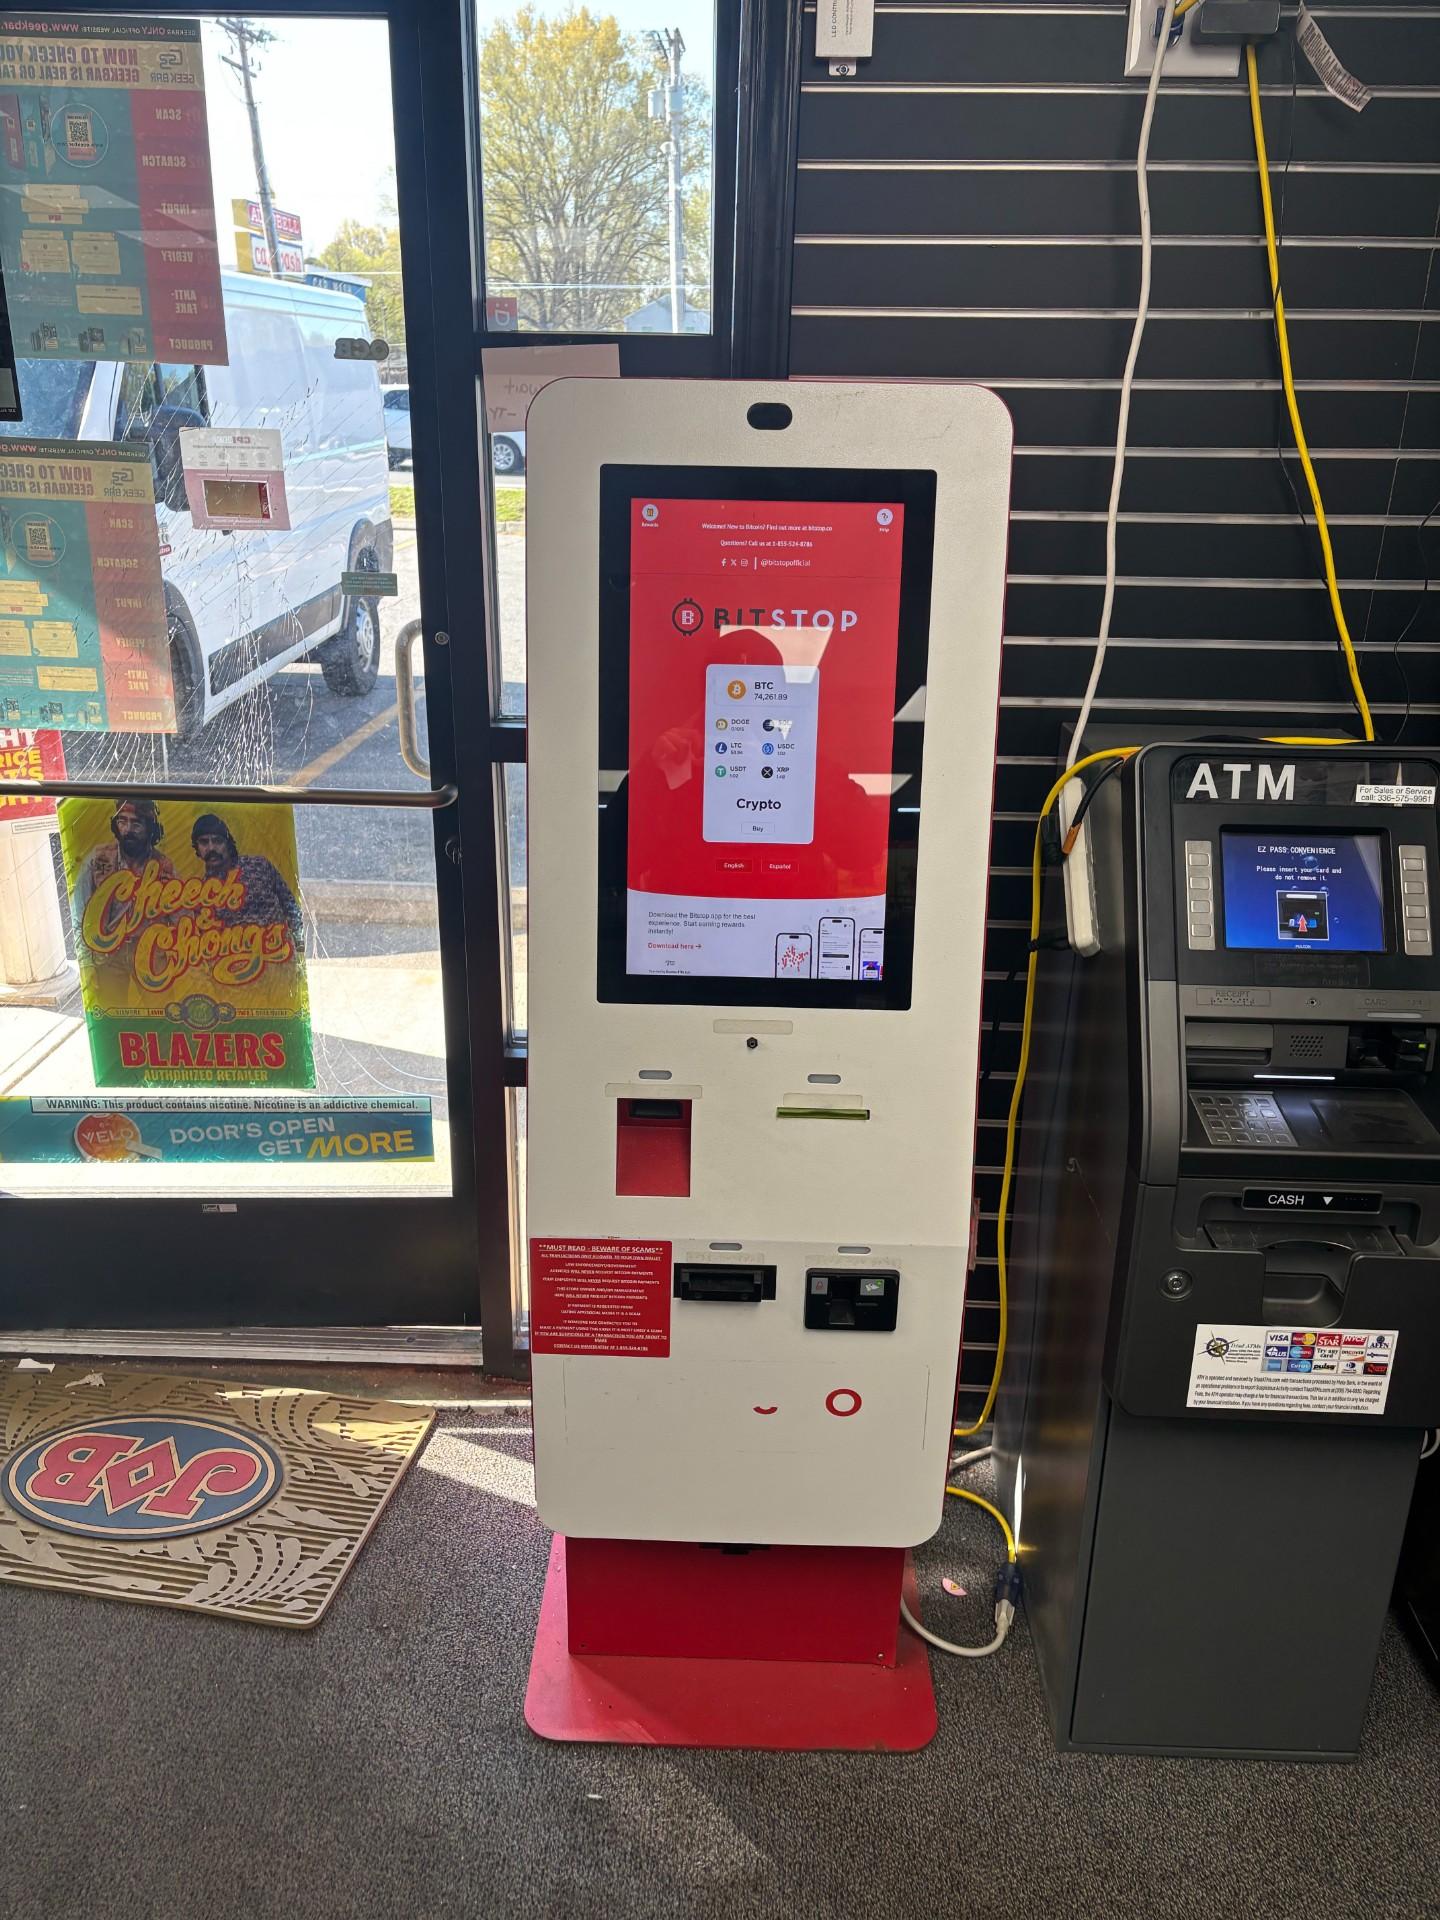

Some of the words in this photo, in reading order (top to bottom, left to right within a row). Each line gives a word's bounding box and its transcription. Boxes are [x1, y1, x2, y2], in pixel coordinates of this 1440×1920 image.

[714, 607, 858, 632] BITSTOP
[754, 682, 774, 690] BTC
[1185, 762, 1296, 800] ATM
[1360, 786, 1372, 795] For
[1374, 787, 1394, 795] Sales
[1404, 788, 1432, 796] Service
[736, 798, 782, 811] Crypto
[752, 824, 764, 833] Buy
[1290, 847, 1336, 855] CONVENIENCE
[82, 859, 248, 953] Cheech
[196, 907, 224, 930] &
[1216, 990, 1250, 998] RECEIPT
[1364, 998, 1388, 1006] CARD
[118, 1031, 286, 1069] BLAZERS
[144, 1070, 213, 1082] AUTHORIZED
[216, 1070, 268, 1082] RETAILER
[46, 1100, 100, 1109] WARNING:
[102, 1100, 124, 1110] This
[126, 1100, 163, 1112] product
[166, 1100, 206, 1110] contains
[210, 1100, 252, 1110] nicotine.
[254, 1100, 296, 1110] Nicotine
[298, 1100, 306, 1110] is
[323, 1100, 368, 1110] addictive
[370, 1100, 418, 1110] chemical.
[82, 1126, 134, 1144] VELO
[169, 1122, 262, 1144] DOOR'S
[268, 1116, 336, 1136] OPEN
[258, 1138, 304, 1156] GET
[306, 1130, 414, 1160] MORE
[1268, 1194, 1304, 1206] CASH
[1318, 1336, 1340, 1346] STAR
[25, 1432, 263, 1520] JOB
